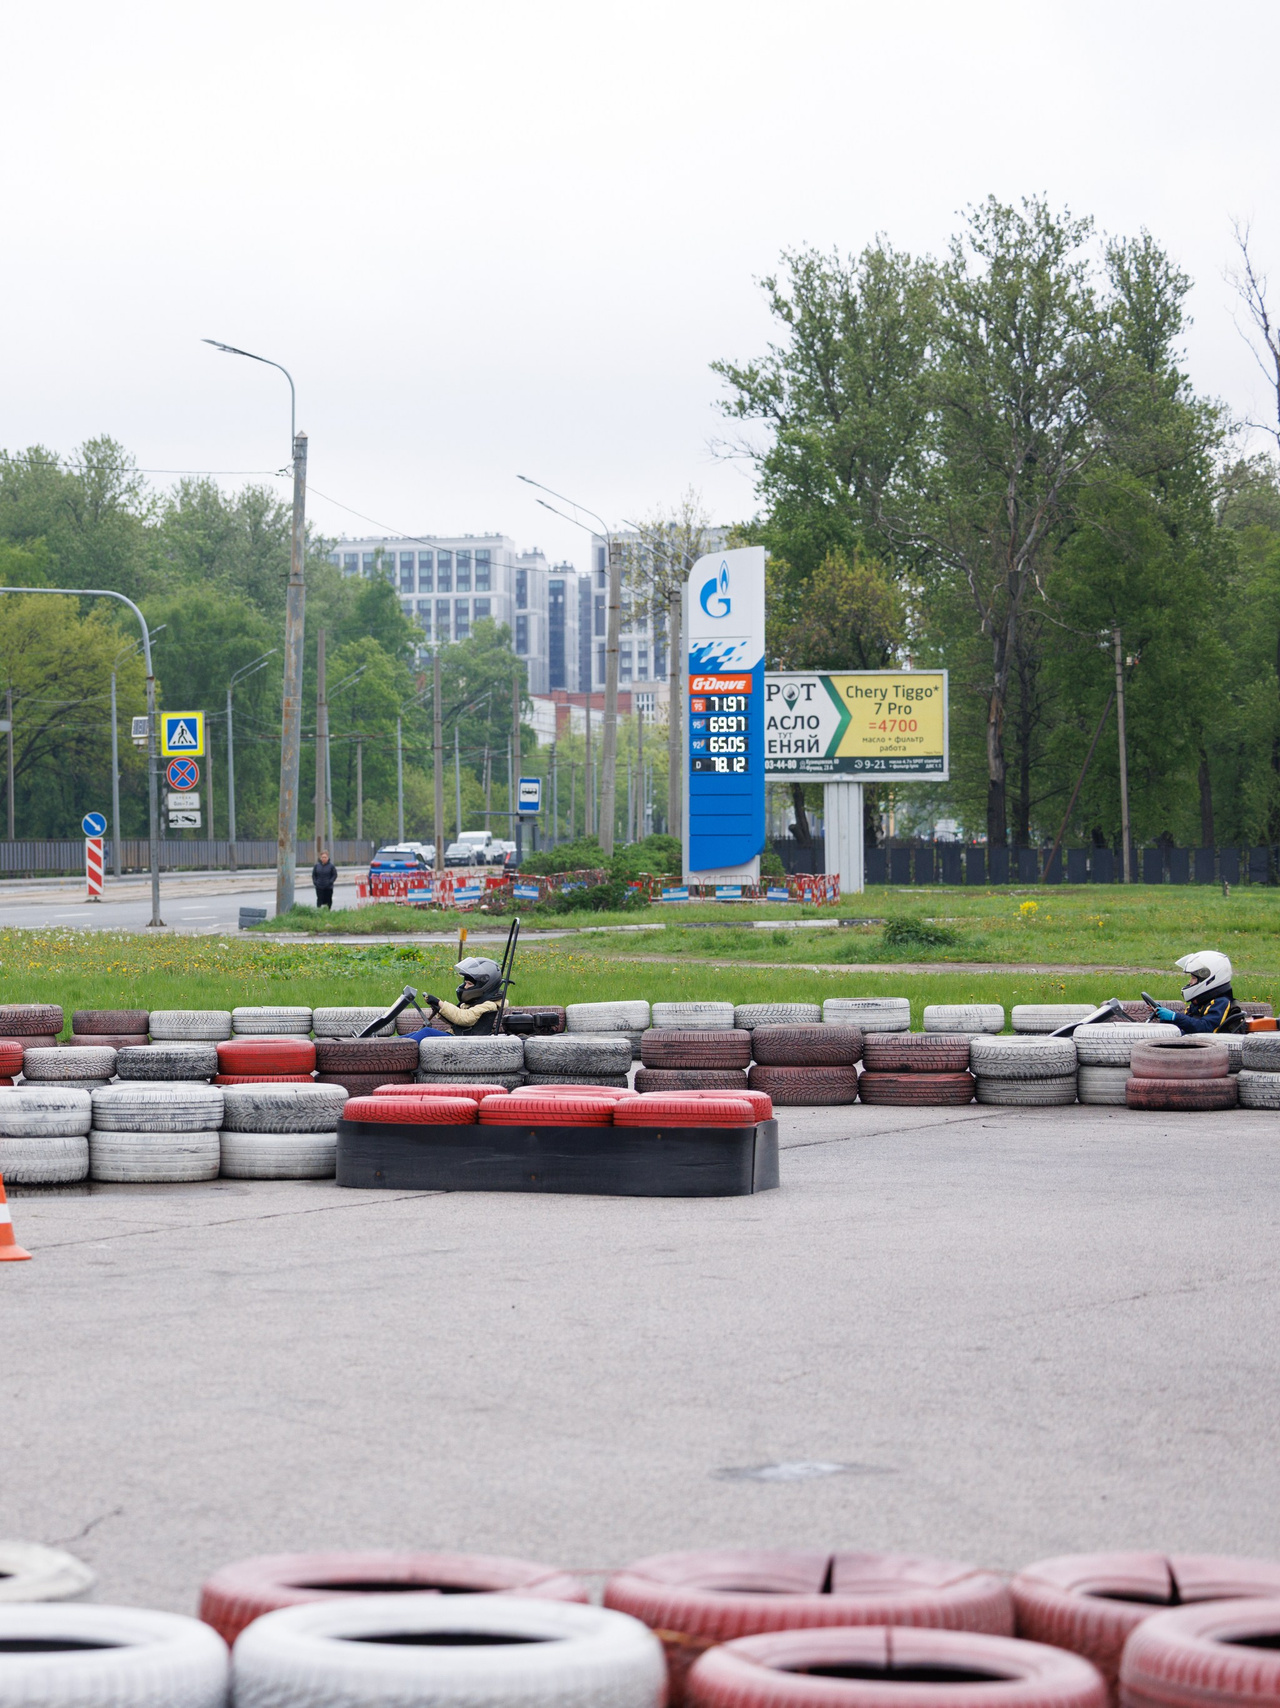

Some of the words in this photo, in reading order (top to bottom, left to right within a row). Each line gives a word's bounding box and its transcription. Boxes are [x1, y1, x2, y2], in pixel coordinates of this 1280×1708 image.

[846, 685, 888, 701] Chery
[694, 702, 703, 711] 95
[874, 702, 883, 715] 7
[888, 702, 913, 715] Pro
[692, 721, 702, 729] 95
[709, 716, 746, 733] 69.97
[766, 715, 820, 730] АСЛО
[692, 741, 702, 749] 92
[709, 736, 746, 753] 65.05
[768, 734, 820, 754] ЕНЯЙ
[894, 736, 924, 744] фильтр
[879, 745, 907, 753] работа
[695, 761, 702, 769] D
[864, 759, 886, 769] 9-21
